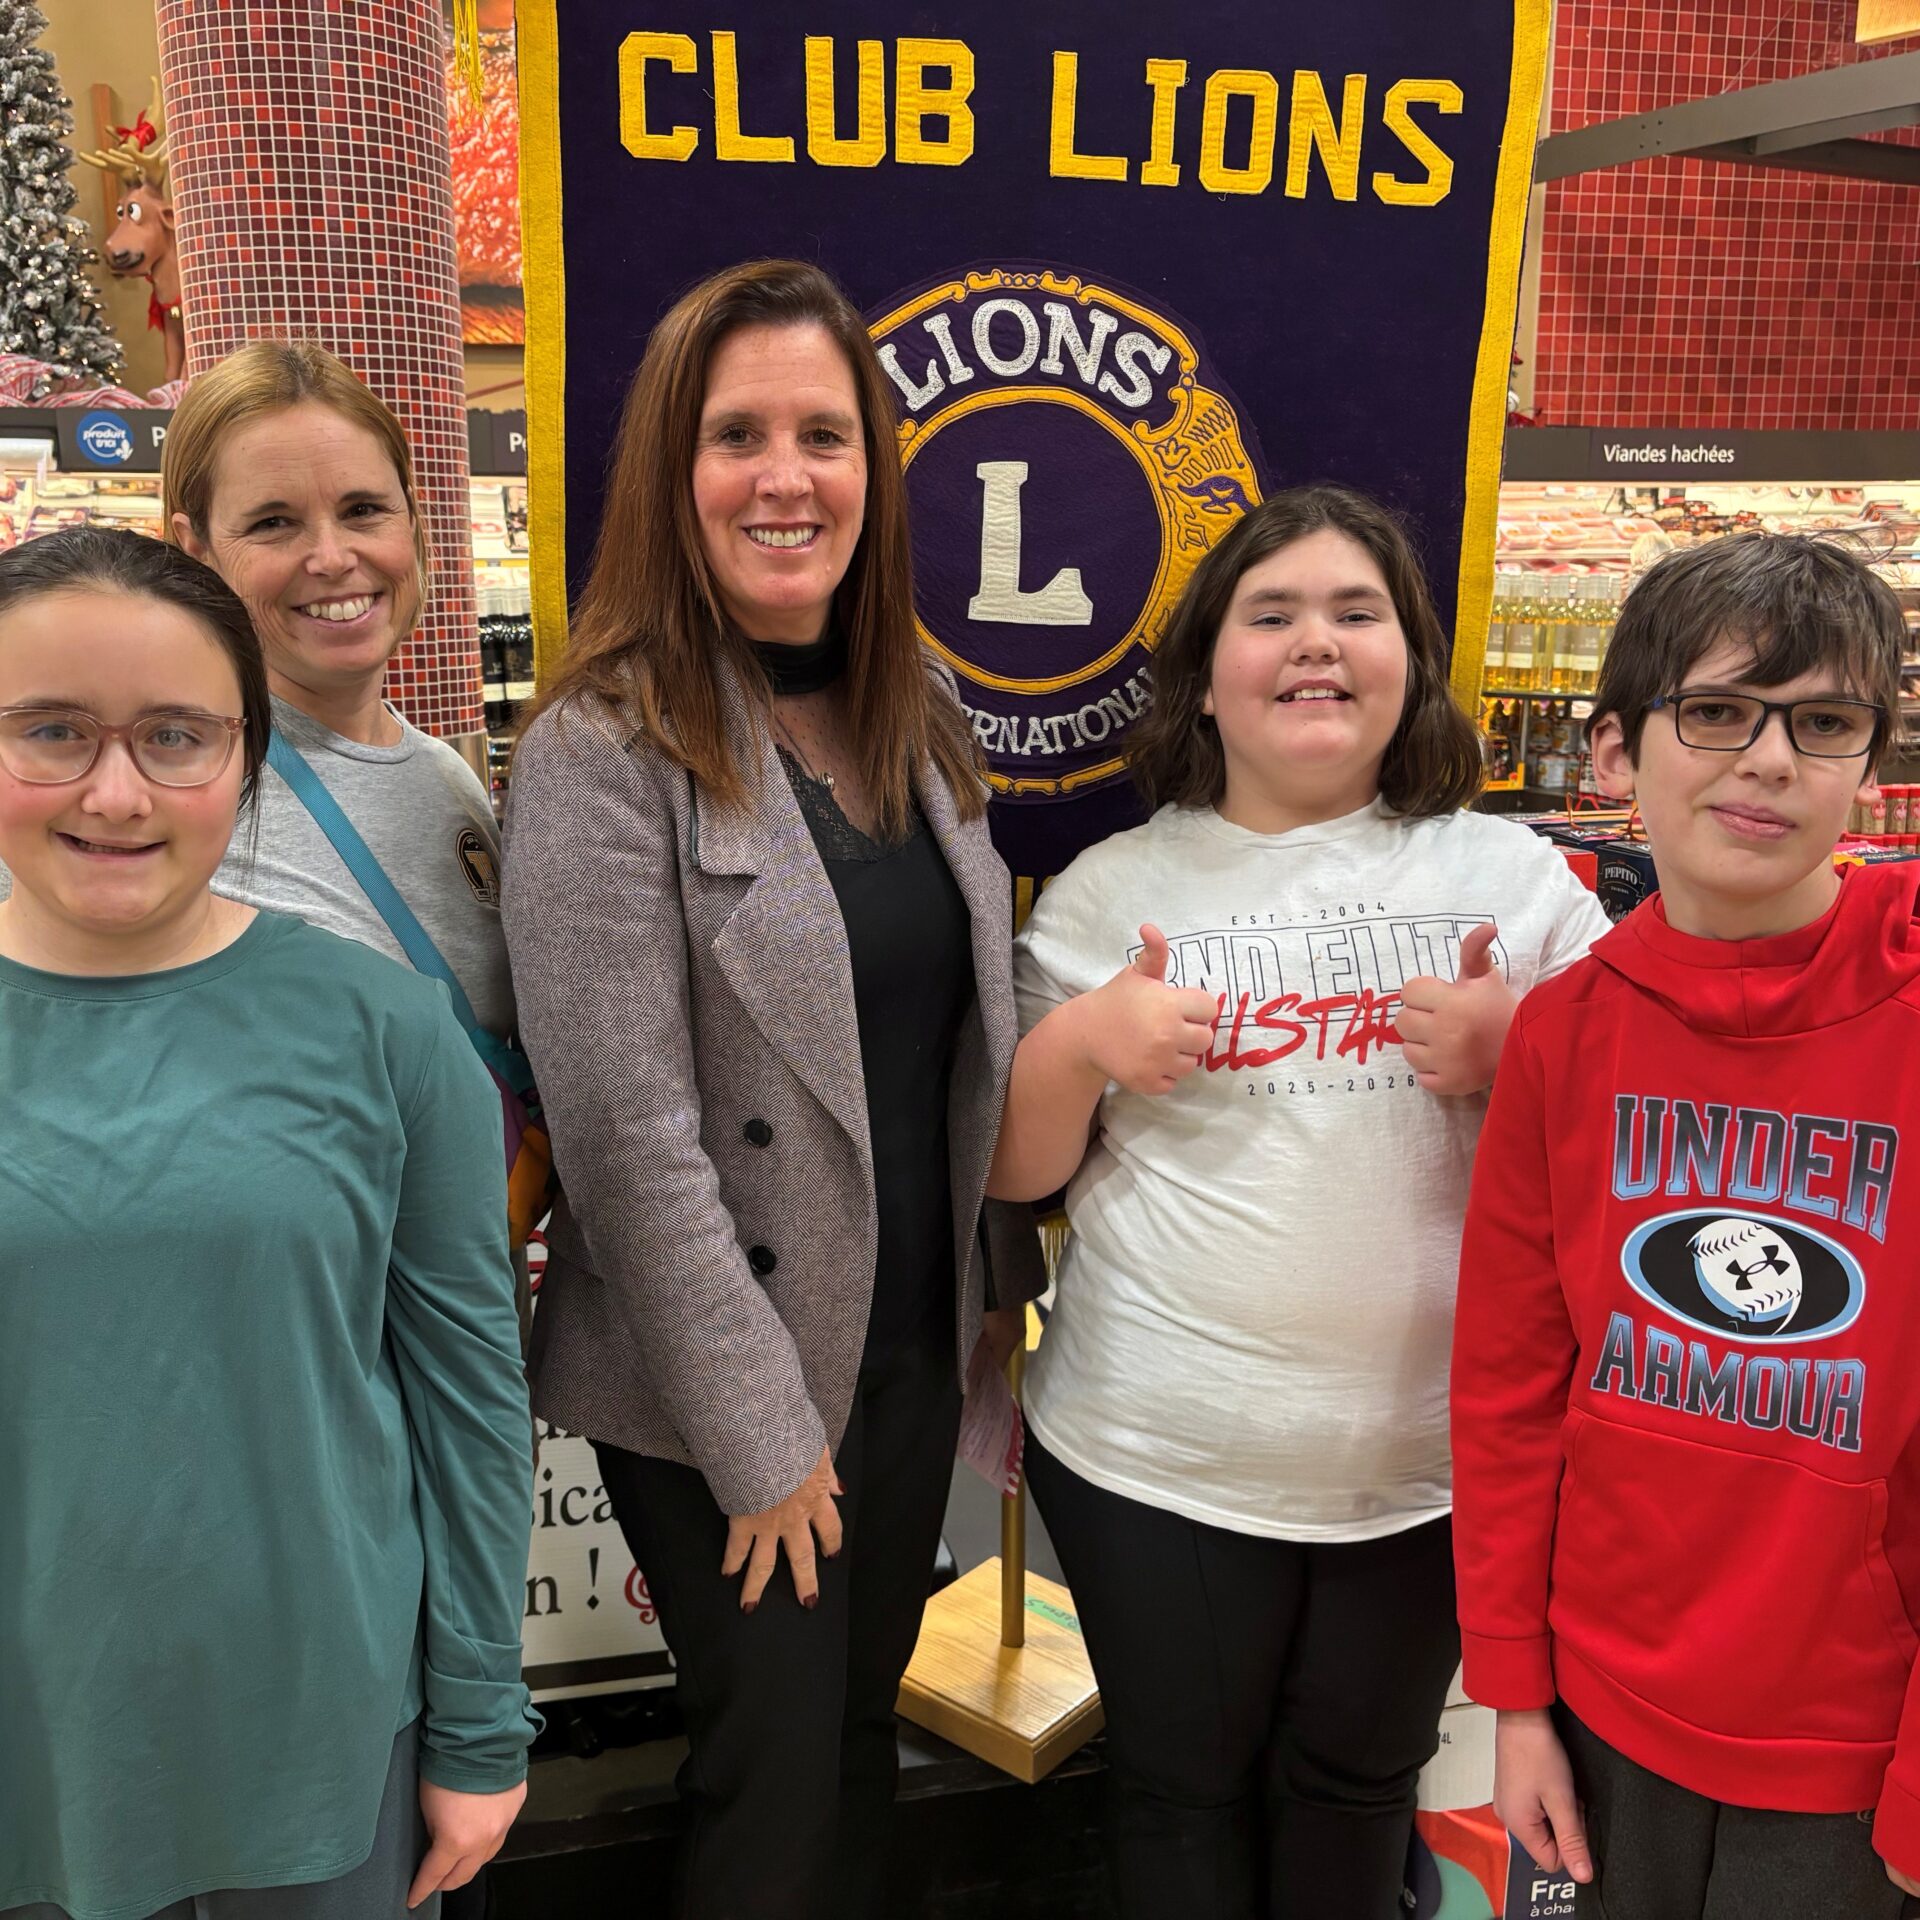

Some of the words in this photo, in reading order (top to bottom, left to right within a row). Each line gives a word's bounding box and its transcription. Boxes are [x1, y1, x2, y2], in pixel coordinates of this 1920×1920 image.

[618, 30, 975, 167] CLUB
[1050, 51, 1464, 206] LIONS
[875, 299, 1172, 411] LIONS
[83, 428, 126, 441] produit
[1603, 443, 1667, 463] Viandes
[1670, 443, 1735, 463] hachées
[968, 461, 1094, 626] L
[961, 667, 1153, 756] RNATIONA
[1604, 866, 1638, 885] PEPITO
[1305, 920, 1502, 1013] ELIT
[1195, 988, 1405, 1072] LLSTA
[1247, 1074, 1415, 1096] 2025-2026
[1611, 1094, 1900, 1245] UNDER
[1590, 1311, 1866, 1453] ARMOUR
[532, 1467, 618, 1528] ica
